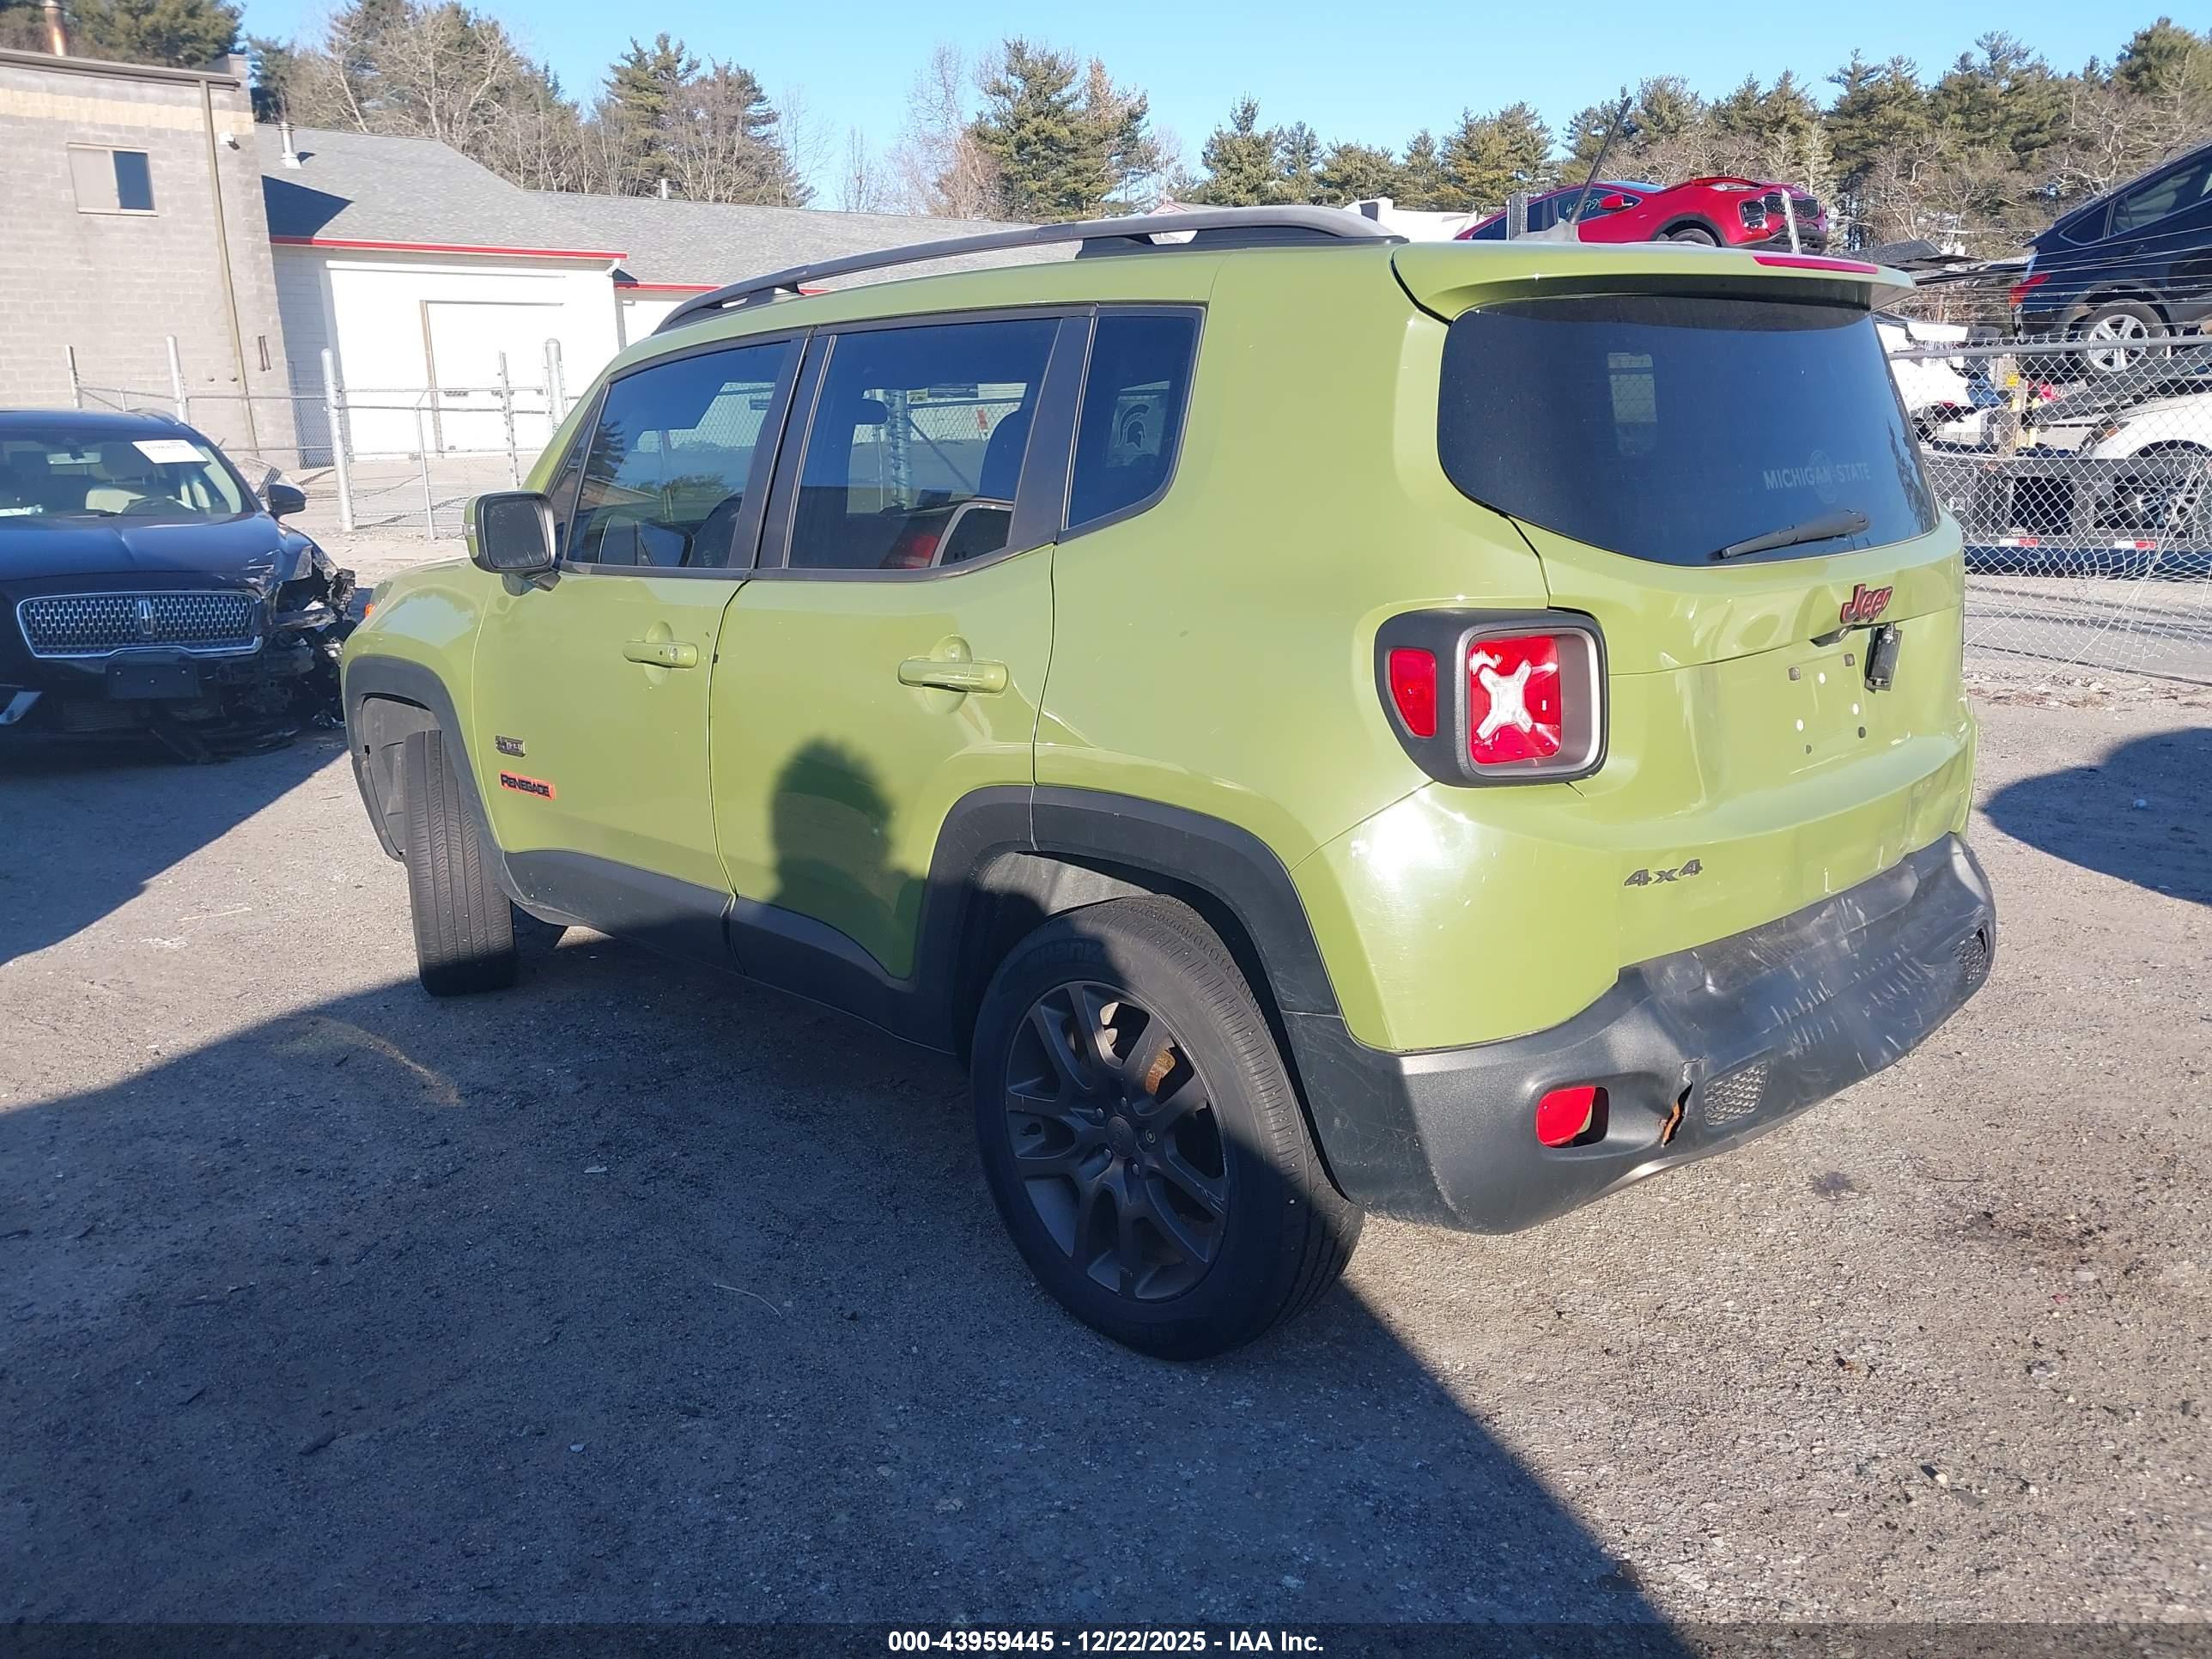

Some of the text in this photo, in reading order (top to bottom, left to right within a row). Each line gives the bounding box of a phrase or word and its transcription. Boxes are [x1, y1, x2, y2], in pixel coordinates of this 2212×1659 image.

[1763, 463, 1872, 489] MICHIGAN STATE
[1839, 583, 1893, 624] Jeep
[500, 772, 552, 799] RENEGADE
[1624, 858, 1704, 887] 4x4
